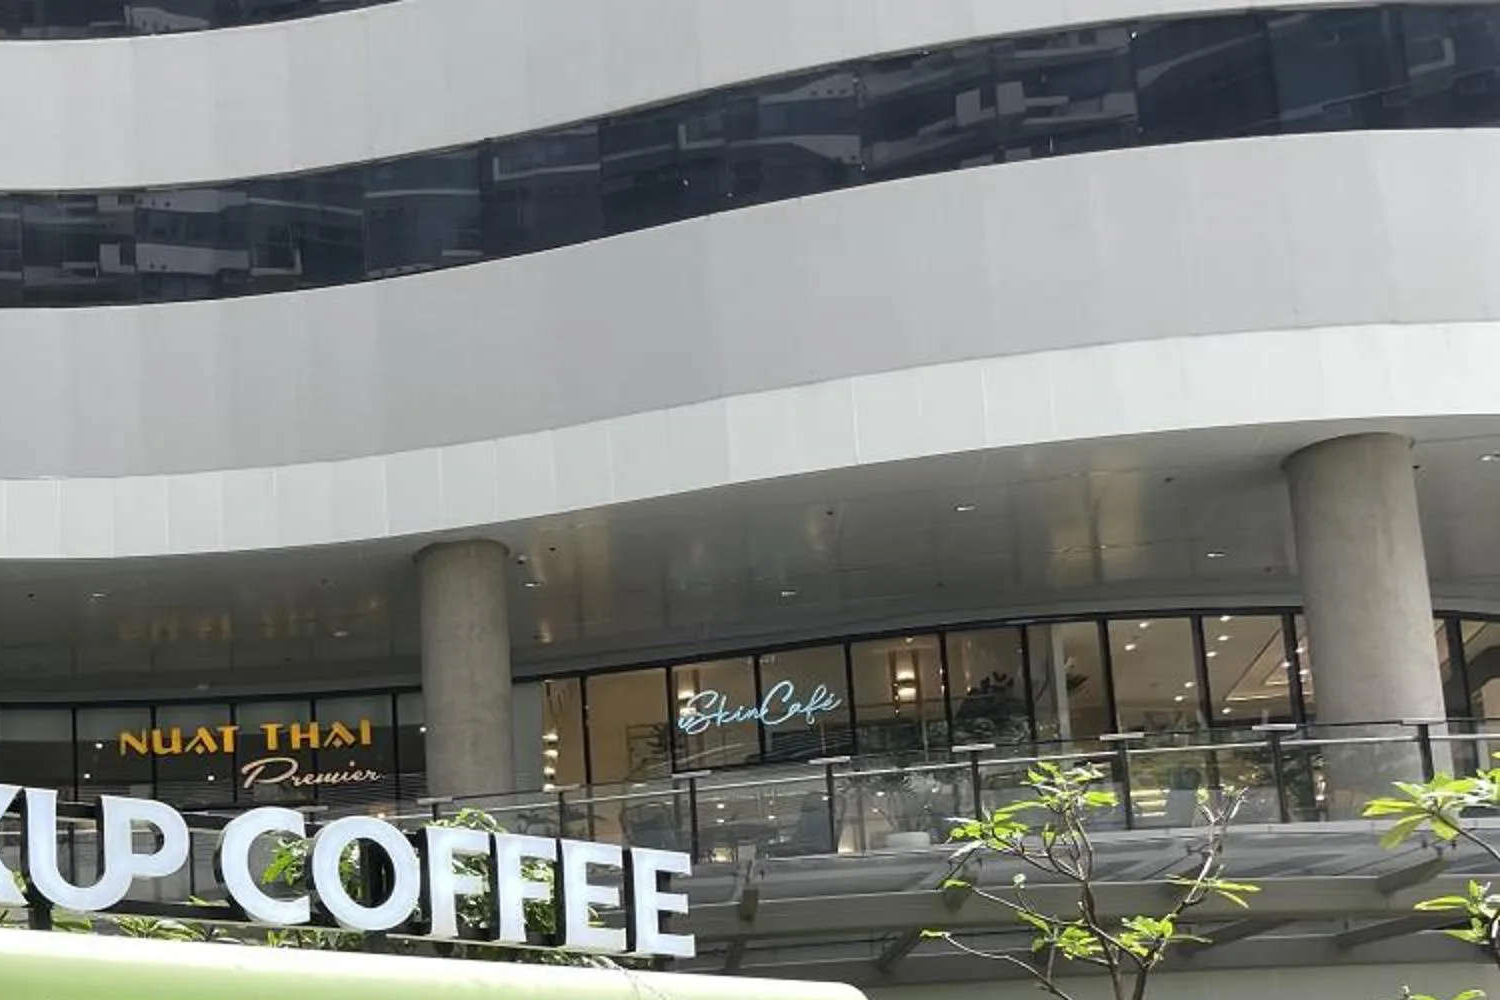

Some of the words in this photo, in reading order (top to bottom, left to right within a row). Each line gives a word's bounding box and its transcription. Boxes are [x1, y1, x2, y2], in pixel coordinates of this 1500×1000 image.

[119, 724, 240, 756] NUAT
[260, 719, 373, 751] THAI
[241, 757, 380, 789] Premier
[216, 806, 697, 959] COFFEE
